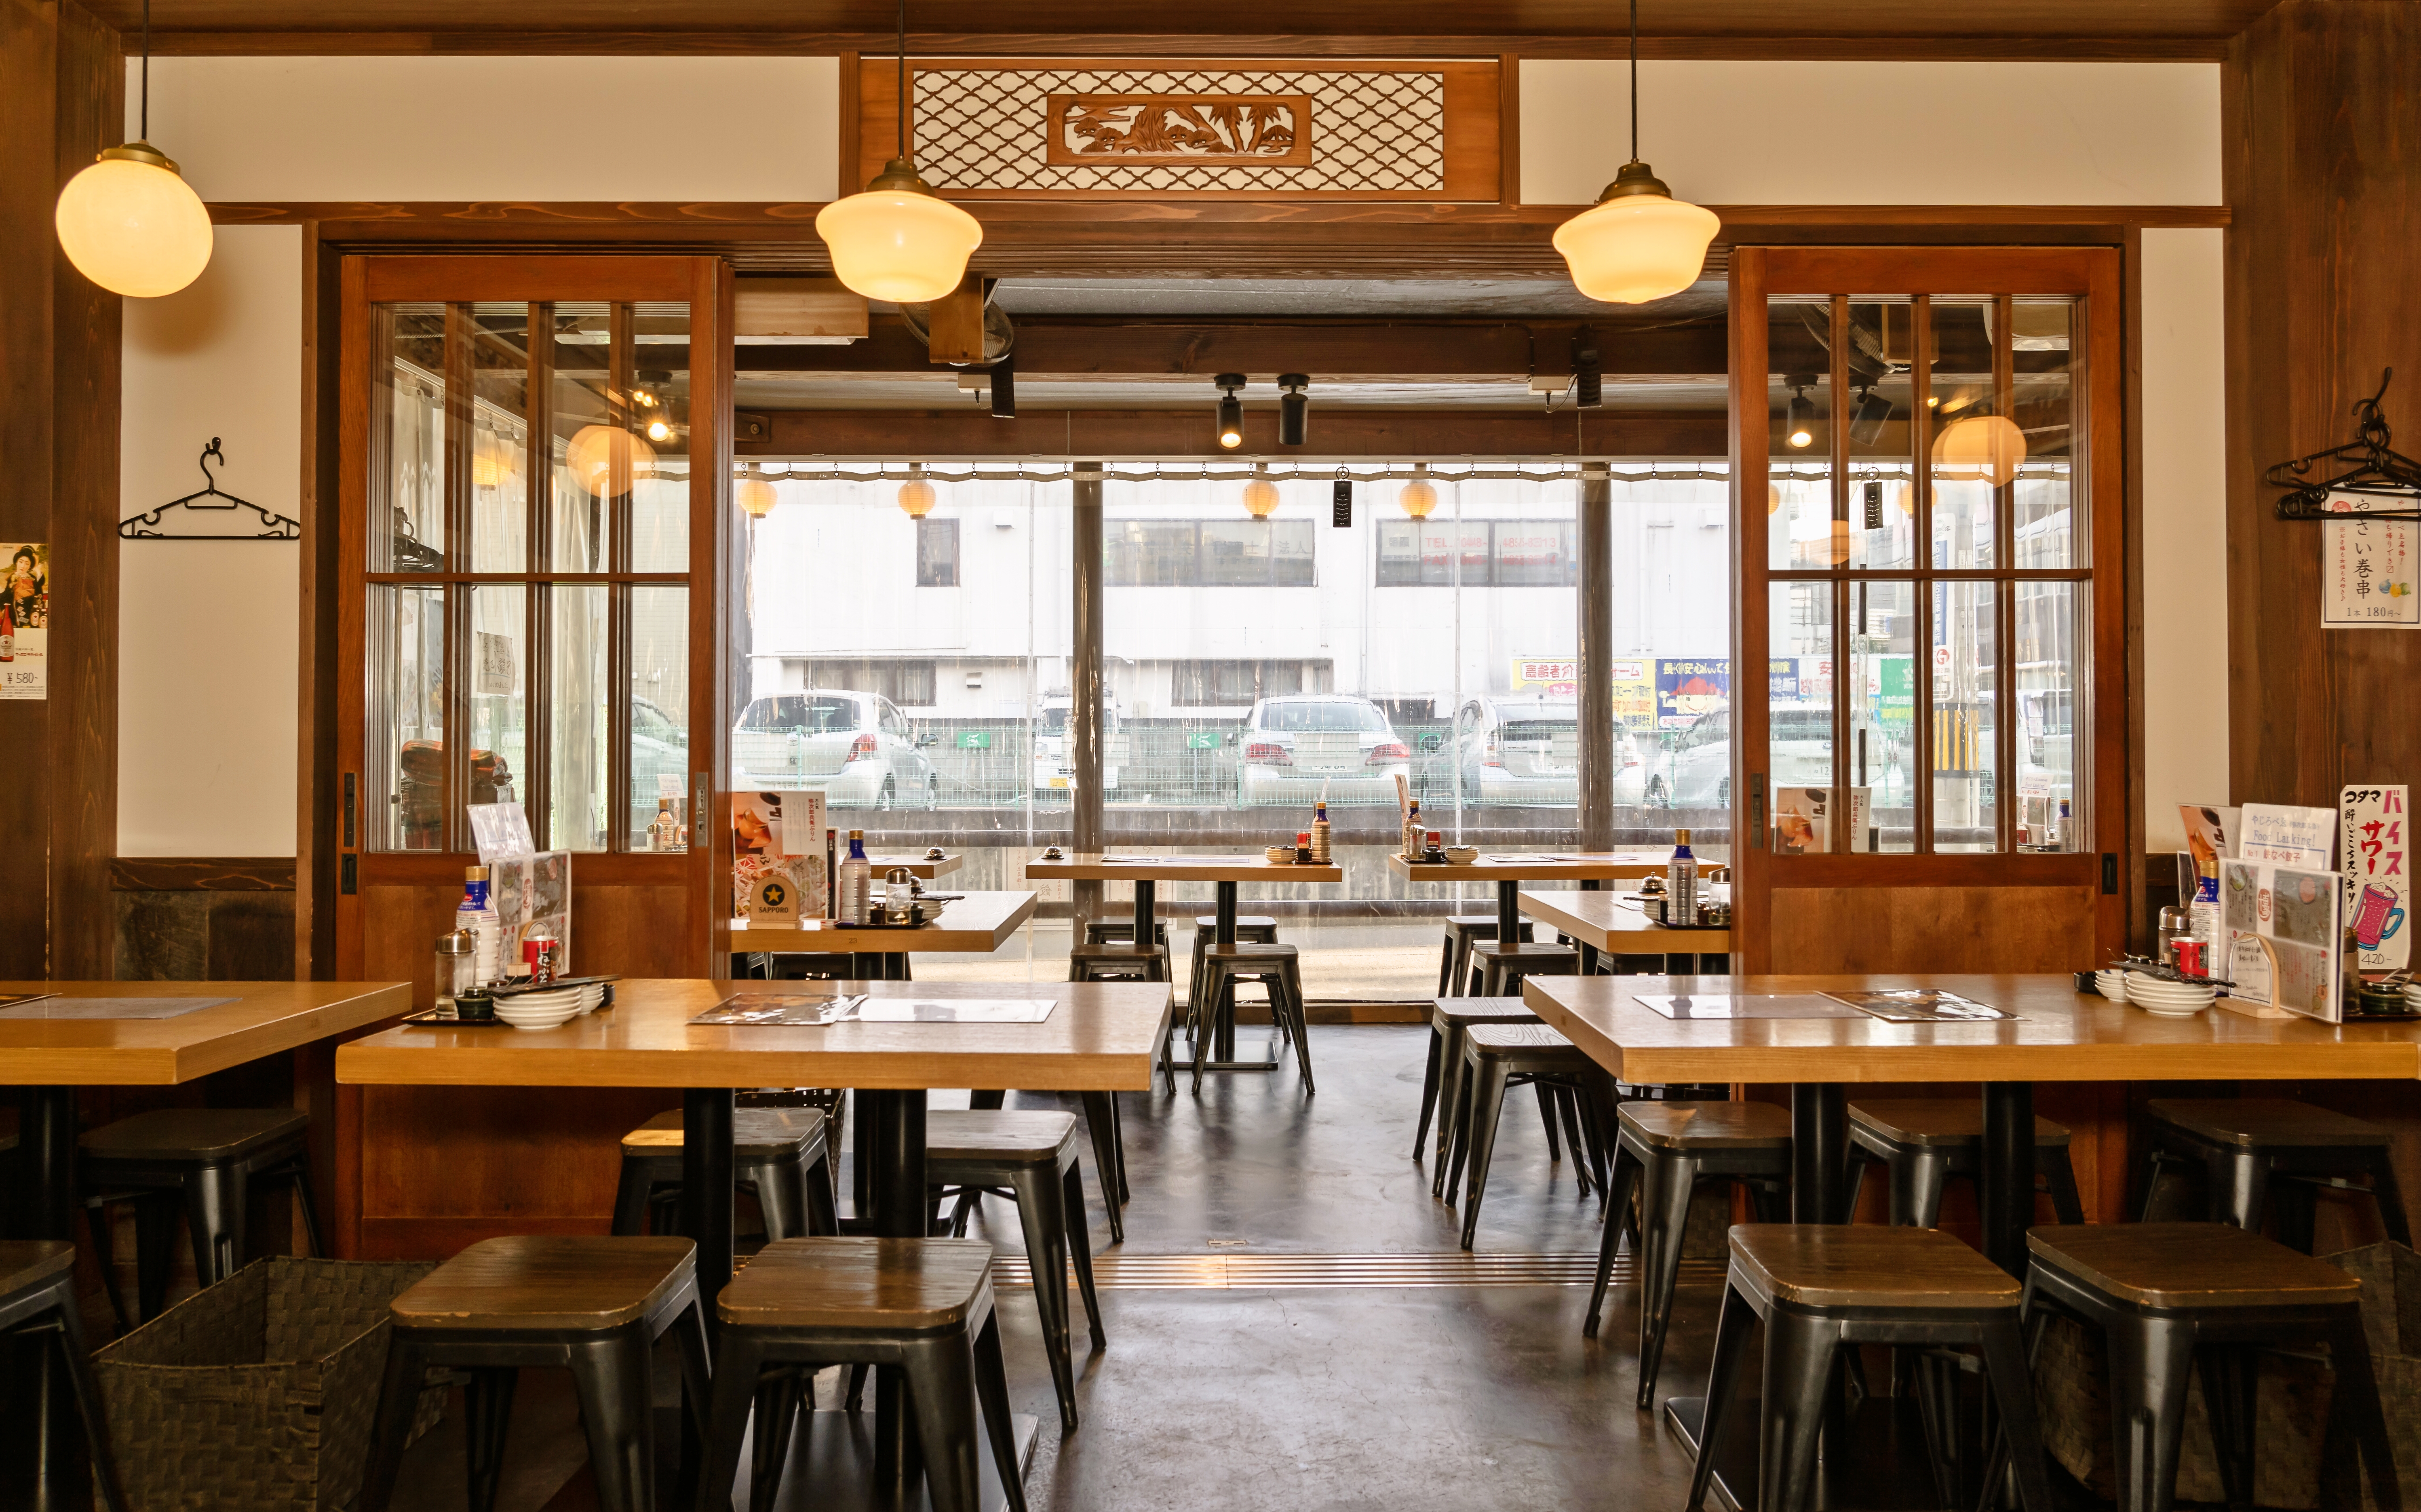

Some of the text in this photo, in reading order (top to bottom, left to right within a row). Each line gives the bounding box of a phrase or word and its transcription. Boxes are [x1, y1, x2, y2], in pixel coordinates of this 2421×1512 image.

[2353, 498, 2374, 599] やさい巻串
[2347, 607, 2361, 617] 1本
[2345, 789, 2381, 804] コダマ
[2253, 830, 2273, 841] Food
[2359, 820, 2385, 875] サワー
[2383, 790, 2402, 875] バイス
